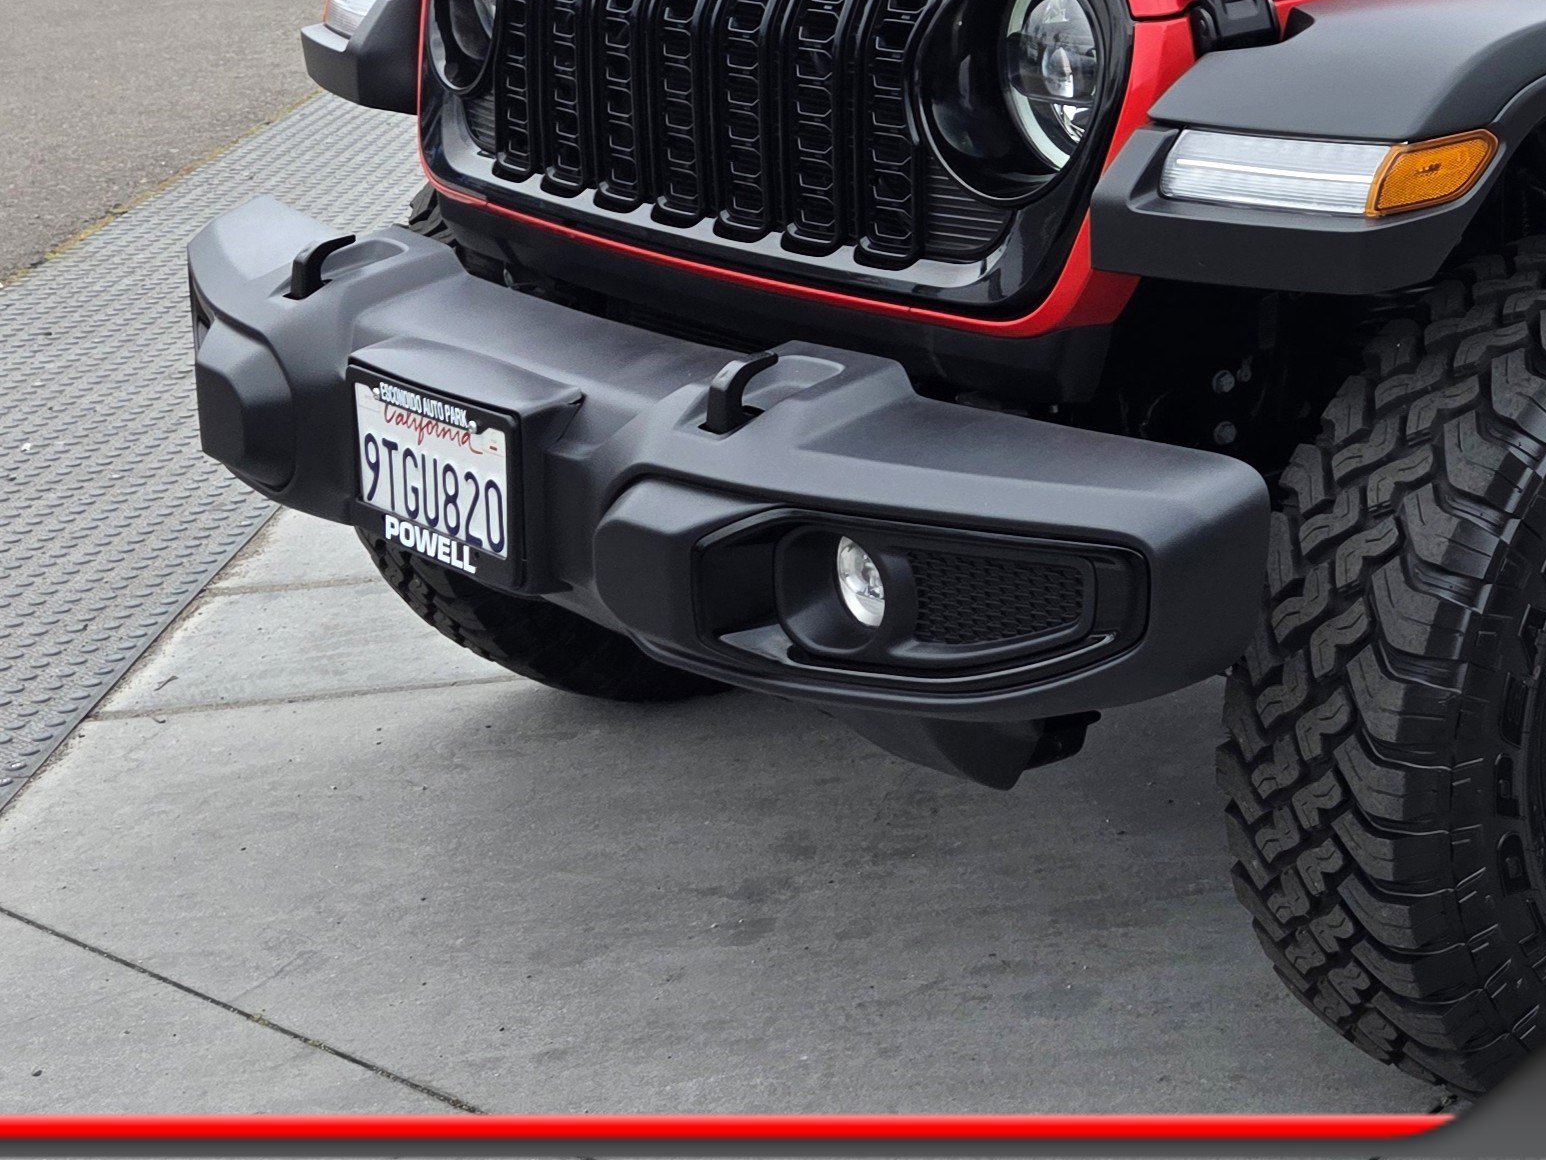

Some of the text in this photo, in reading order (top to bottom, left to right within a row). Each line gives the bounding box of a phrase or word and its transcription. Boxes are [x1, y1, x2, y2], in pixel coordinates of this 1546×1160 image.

[379, 381, 469, 428] ESCONDIDO AUTO PARK
[383, 403, 484, 455] California
[363, 432, 505, 554] 9TGU820
[385, 514, 477, 575] POWELL
